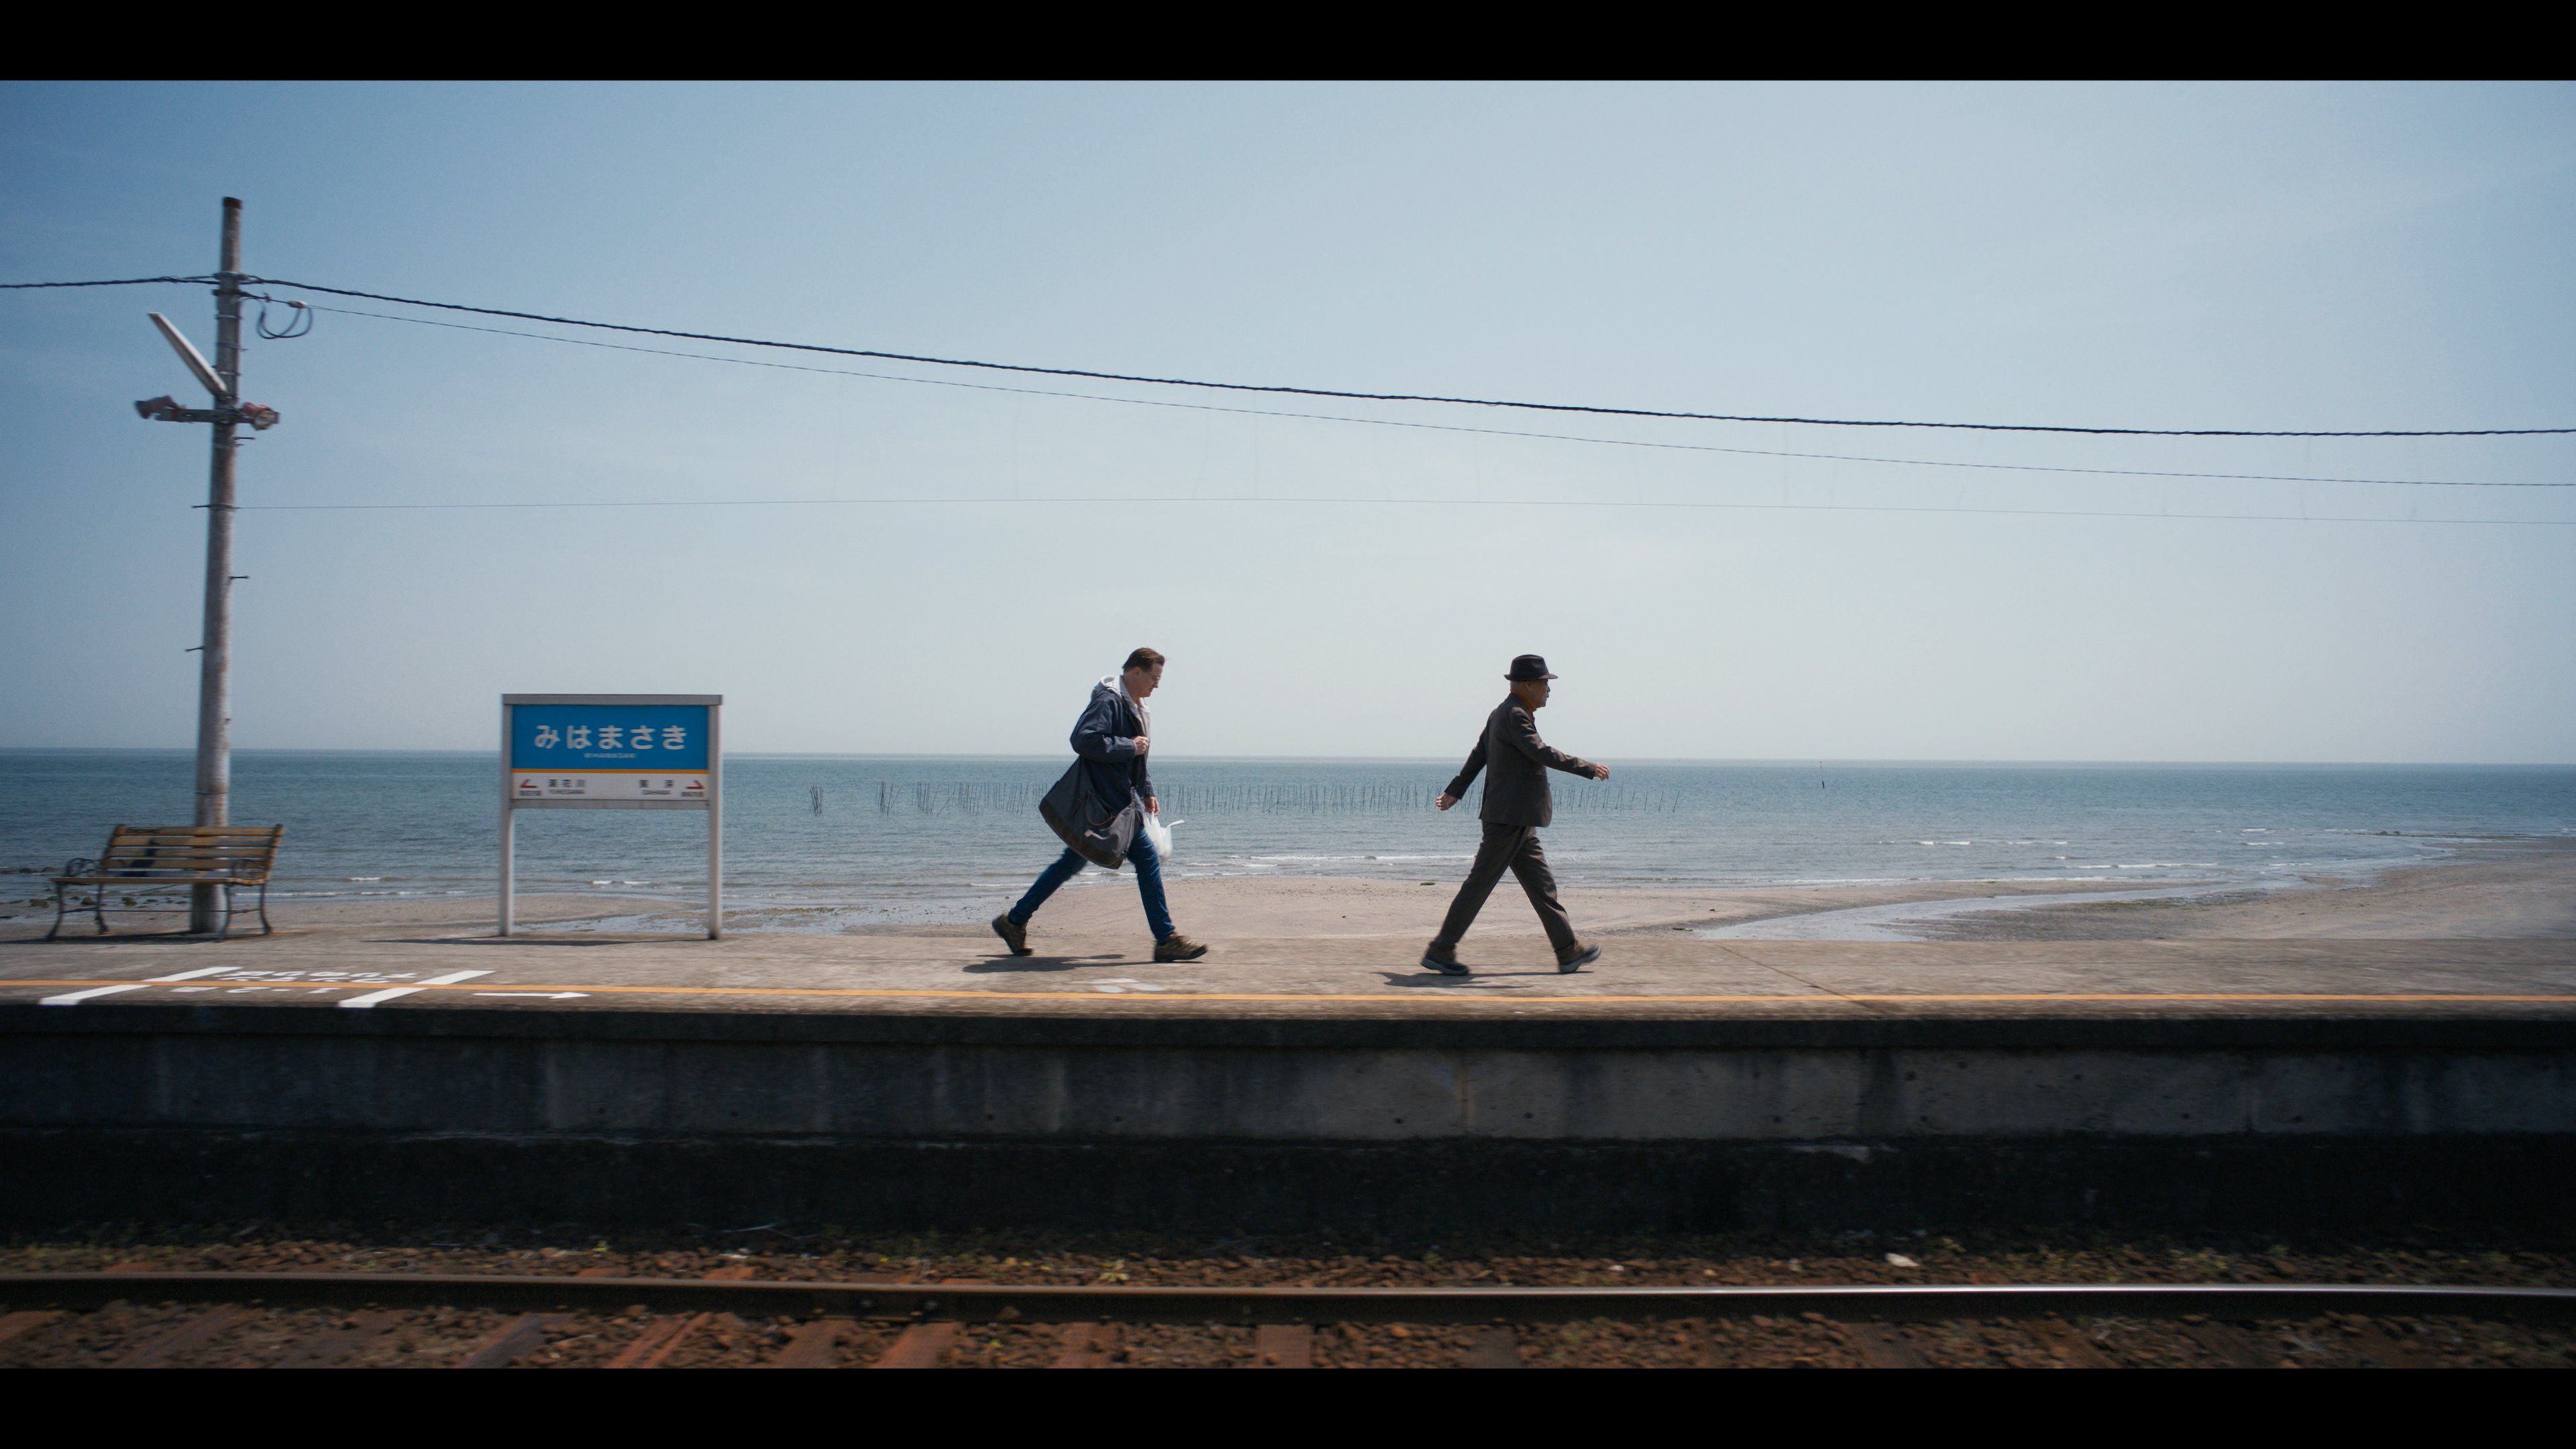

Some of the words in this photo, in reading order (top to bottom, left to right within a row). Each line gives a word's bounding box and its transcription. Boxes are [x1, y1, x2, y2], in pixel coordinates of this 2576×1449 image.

[534, 725, 687, 750] みはまさき
